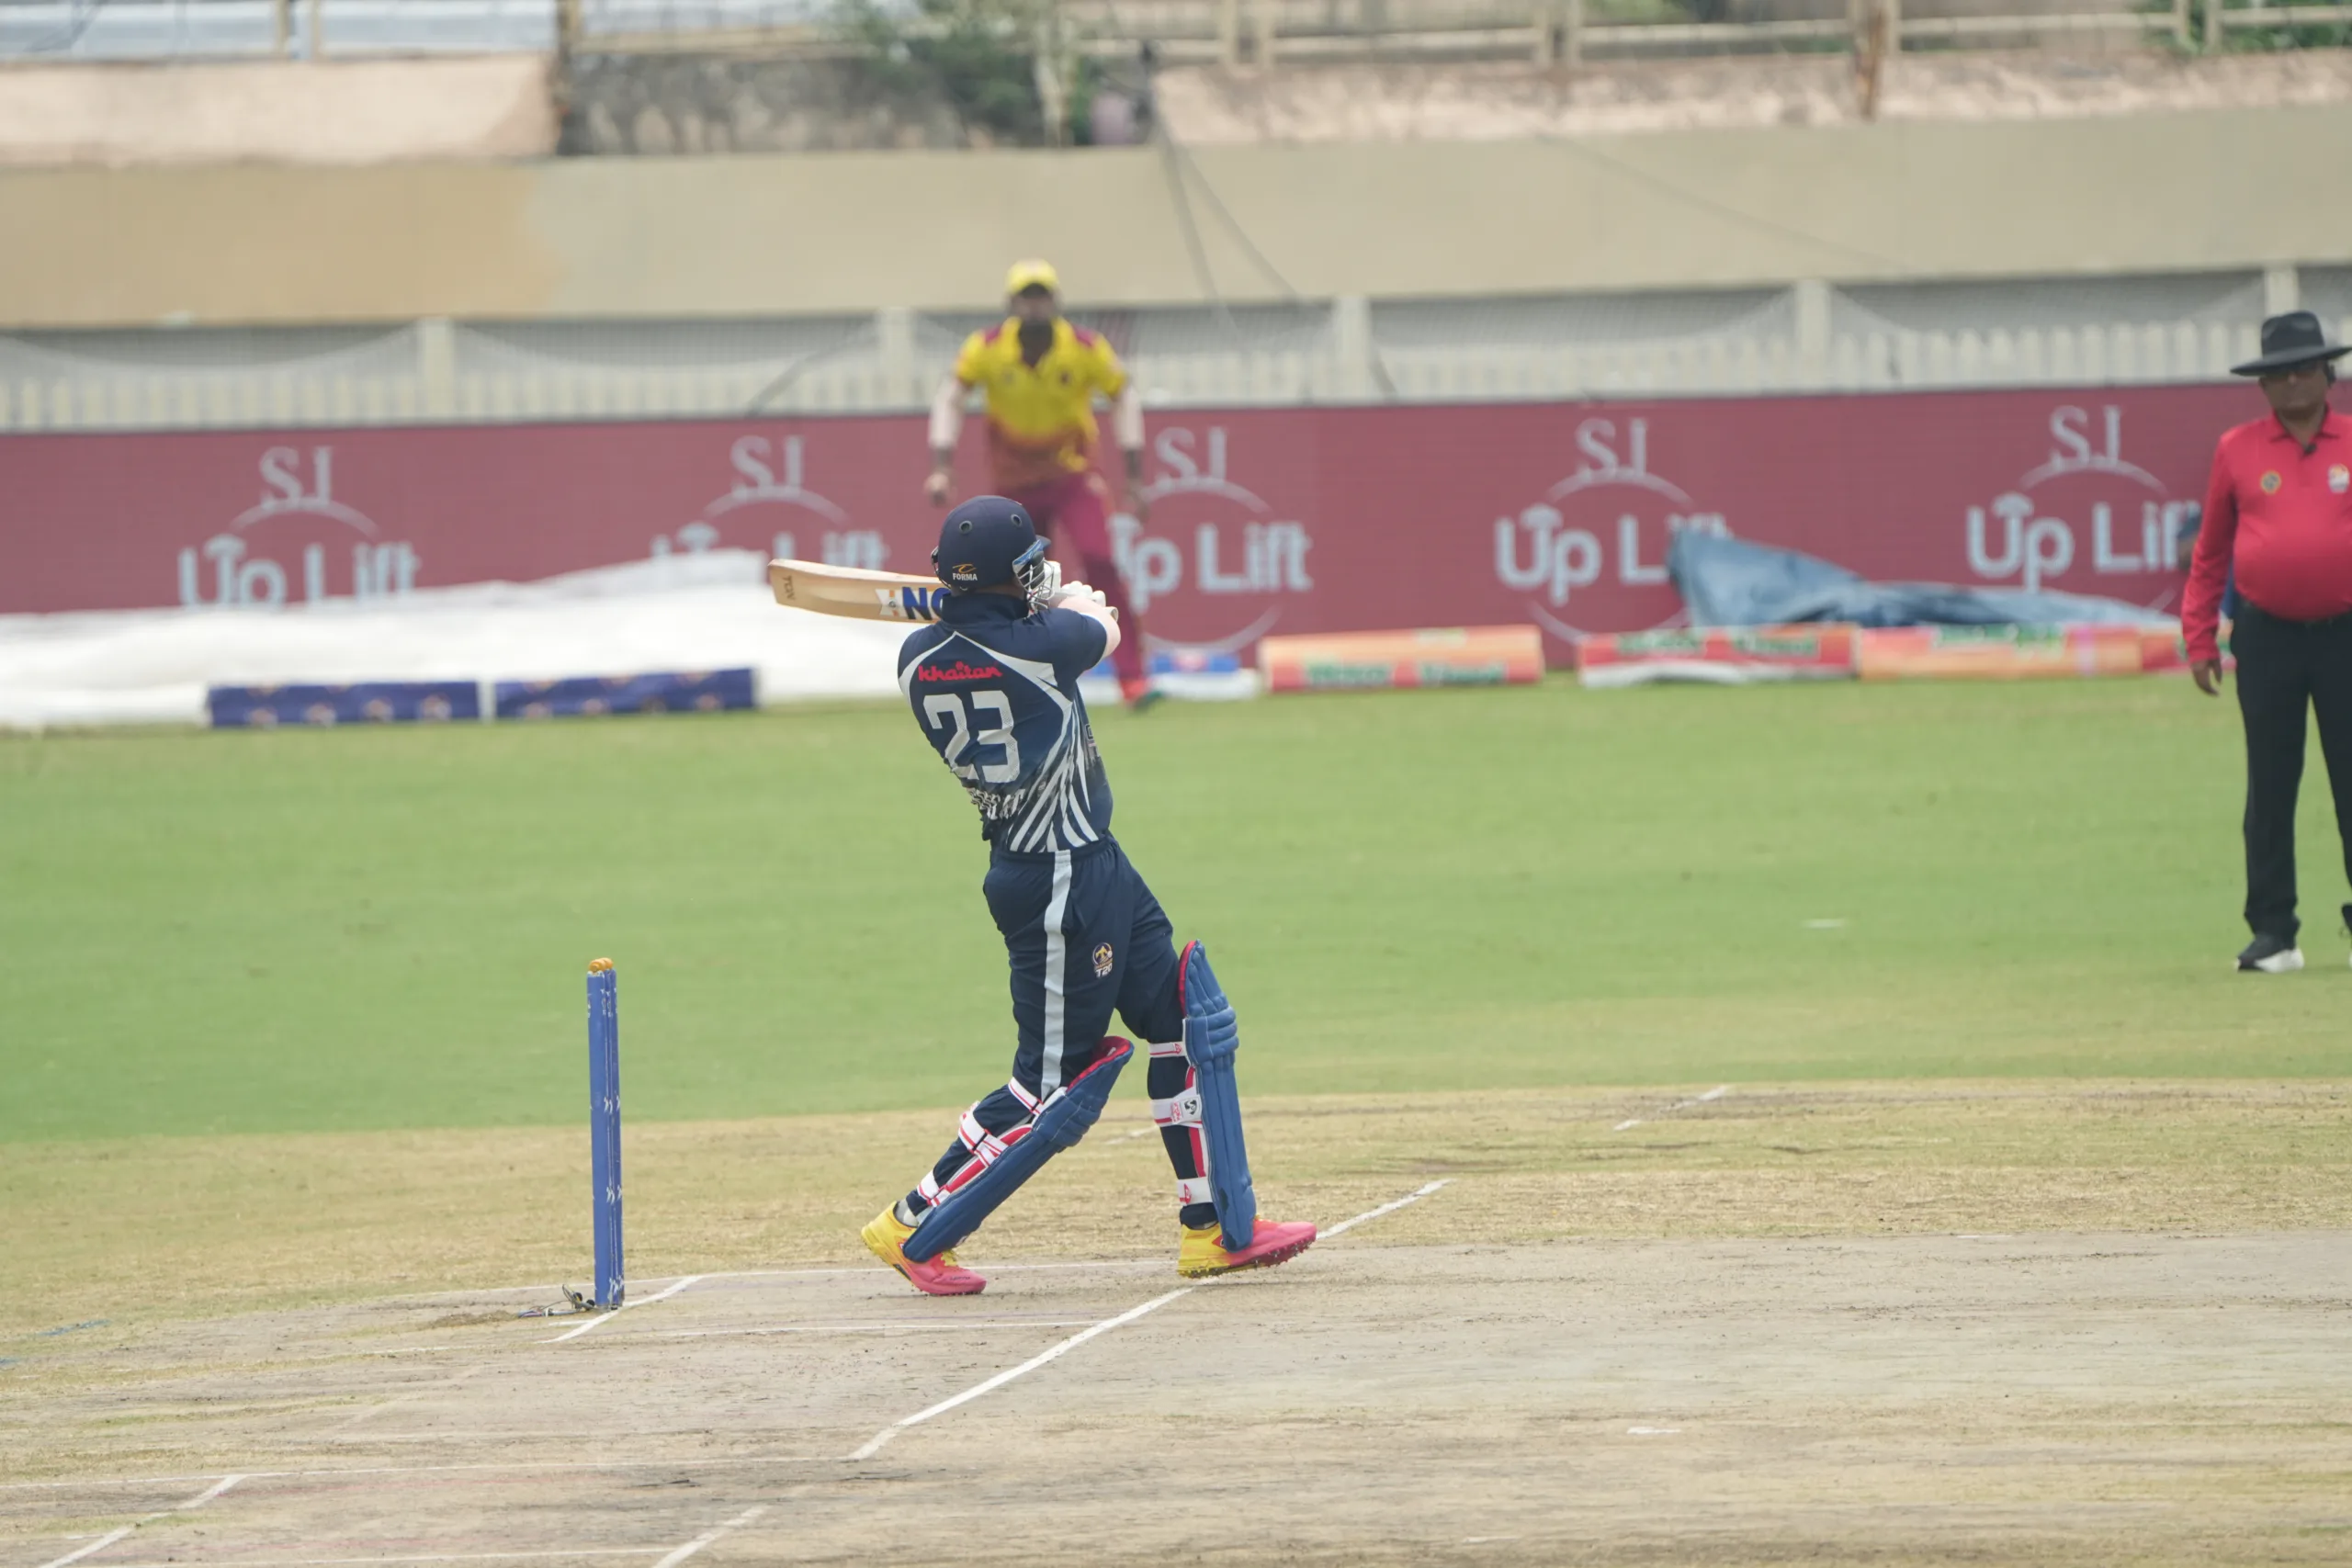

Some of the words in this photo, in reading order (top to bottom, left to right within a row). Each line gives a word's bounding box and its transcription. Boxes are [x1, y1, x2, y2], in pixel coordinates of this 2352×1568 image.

[952, 572, 978, 581] FORMA
[1196, 521, 1315, 593] Lift
[1494, 502, 1602, 607] Up
[1965, 491, 2075, 595] Up
[2092, 500, 2201, 575] Lif
[919, 661, 1002, 682] khaitan
[922, 690, 1021, 784] 23
[1095, 963, 1113, 977] T20
